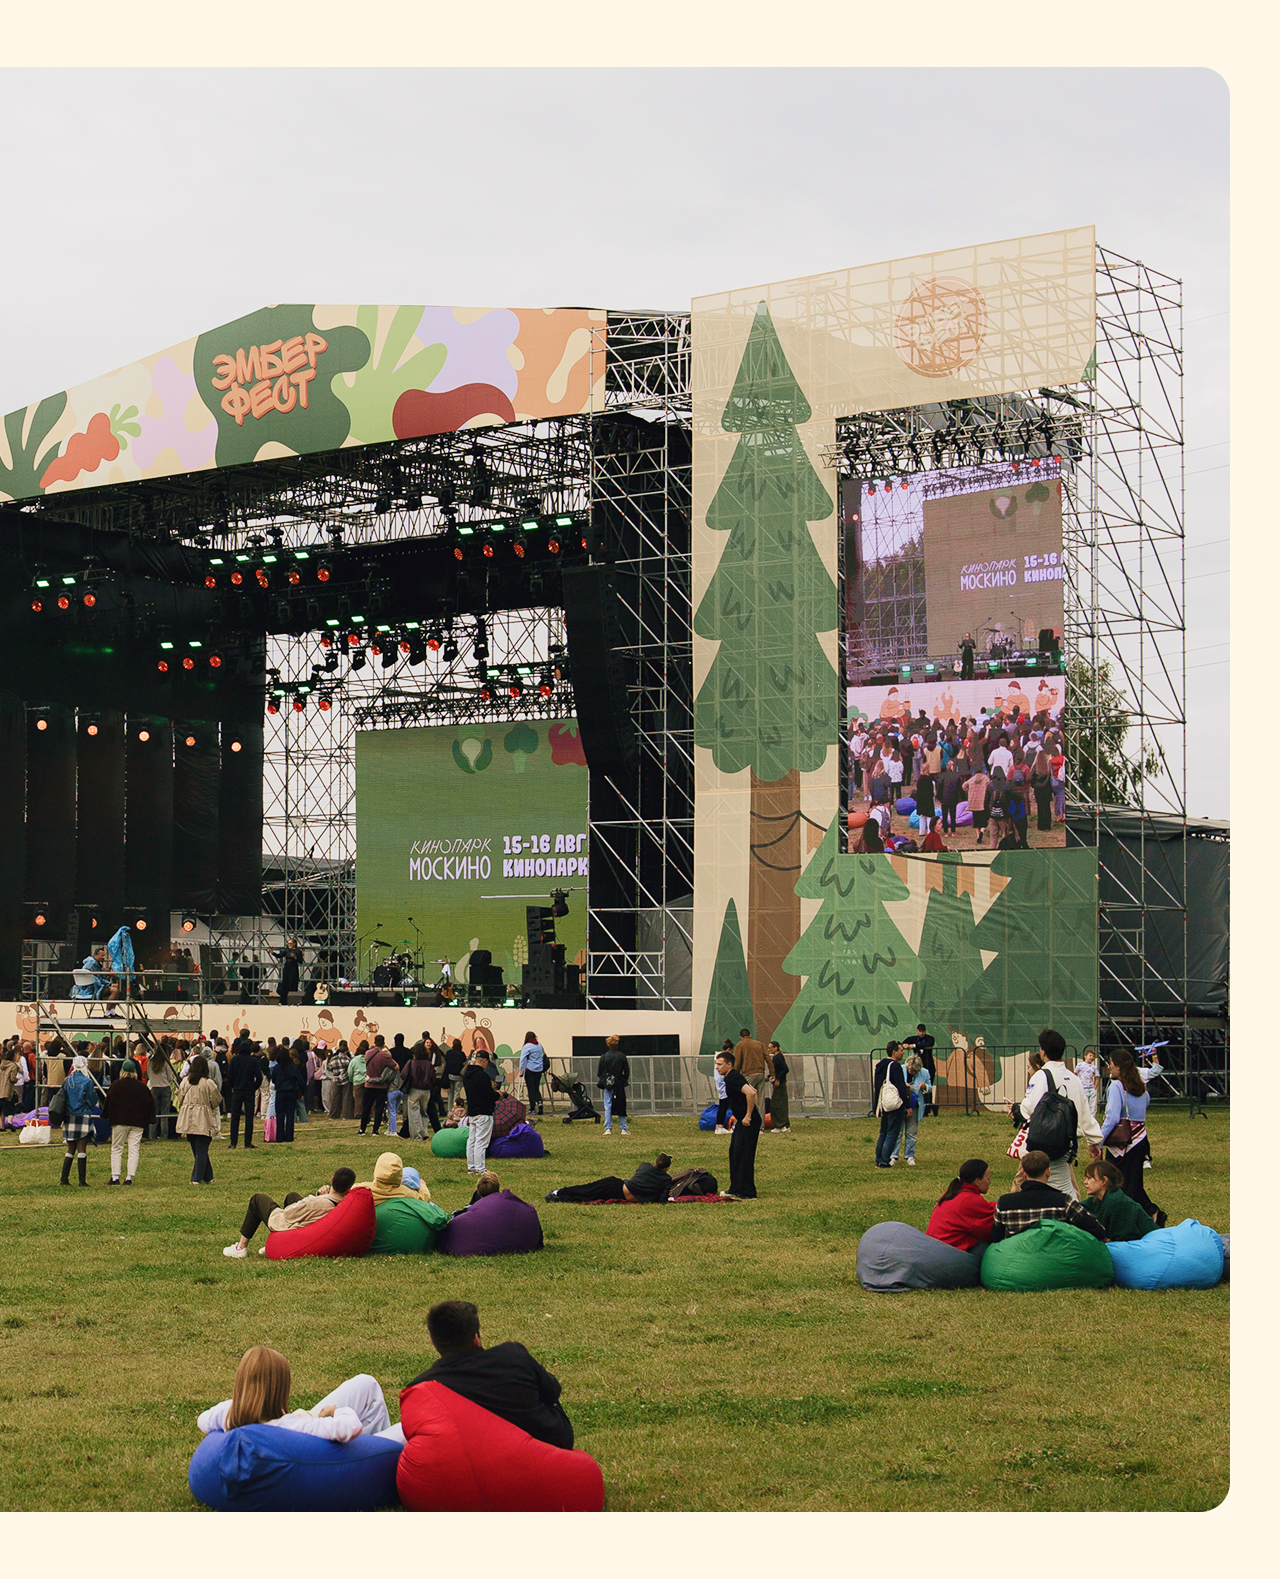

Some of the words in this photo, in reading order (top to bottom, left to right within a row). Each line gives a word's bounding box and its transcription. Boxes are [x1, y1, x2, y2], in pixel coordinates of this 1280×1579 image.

[211, 332, 328, 391] ЭМБЕР
[221, 368, 317, 426] ФЕСТ
[961, 558, 1017, 574] КИНОПАРК
[1023, 552, 1058, 569] 15-16
[960, 569, 1017, 591] МОСКИНО
[410, 838, 492, 855] КИНОПАРК
[503, 834, 551, 855] 15-16
[555, 834, 587, 854] АВГ
[409, 855, 492, 881] МОСКИНО
[503, 857, 589, 878] КИНОПАРК
